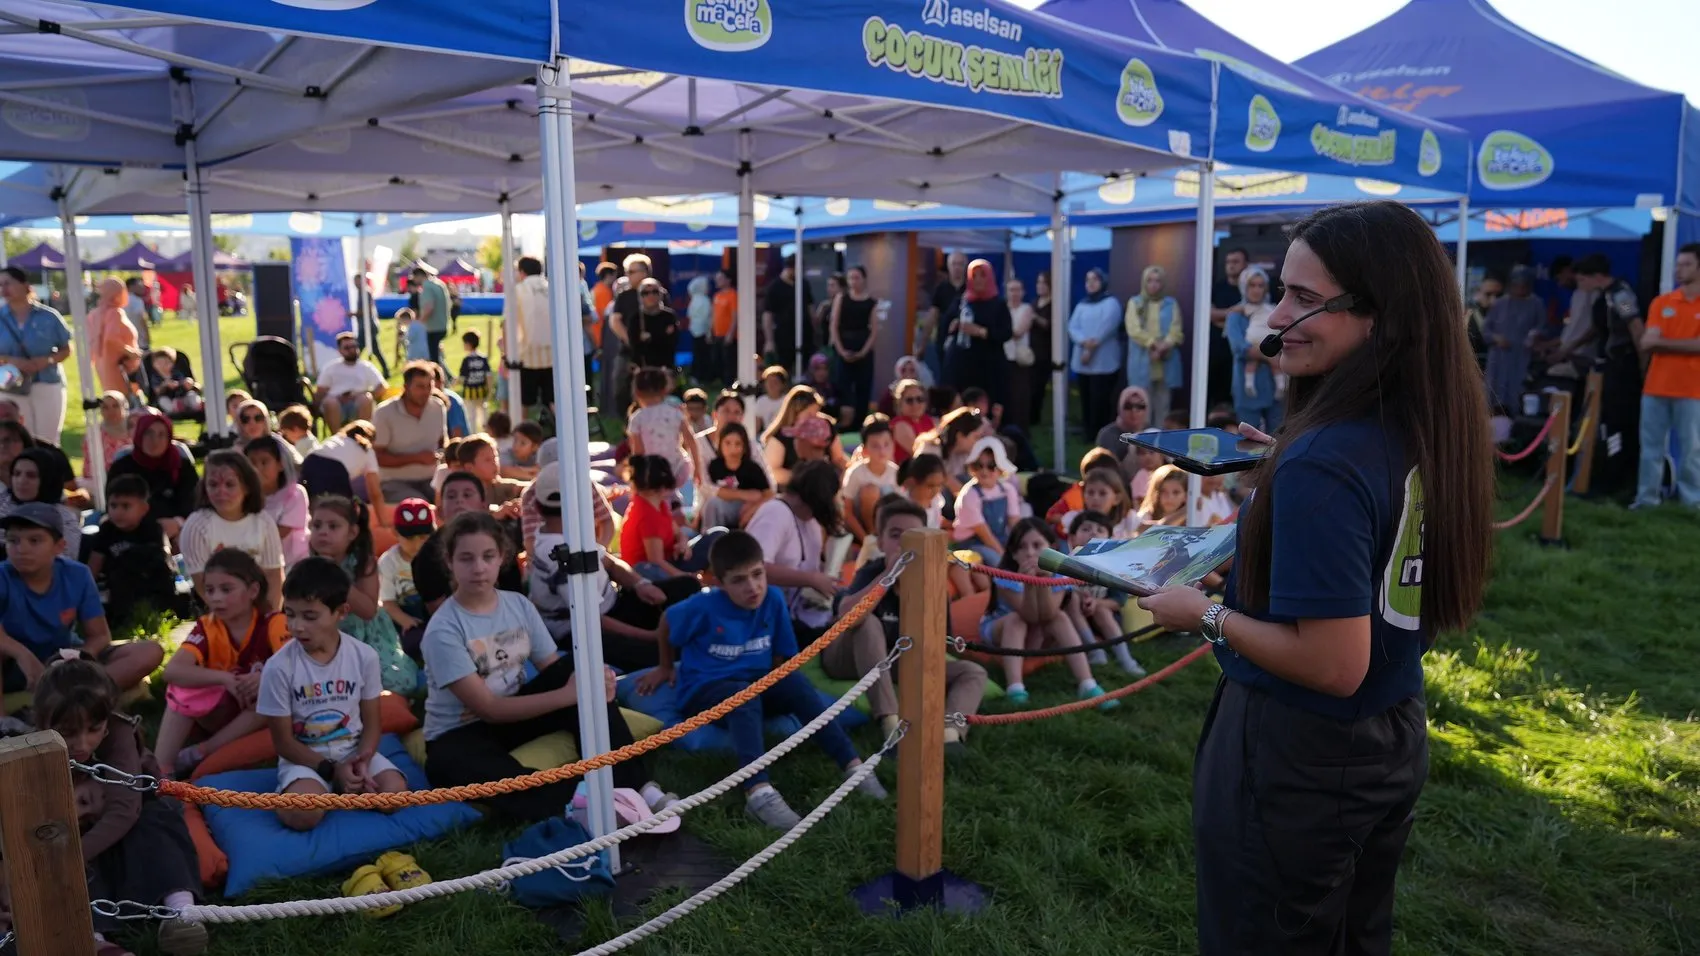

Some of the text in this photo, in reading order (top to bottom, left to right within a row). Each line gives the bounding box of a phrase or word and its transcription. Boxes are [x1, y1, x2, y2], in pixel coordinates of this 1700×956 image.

[951, 7, 1022, 41] aselsan
[864, 17, 1062, 95] ÇOCUK ŞENLİĞİ
